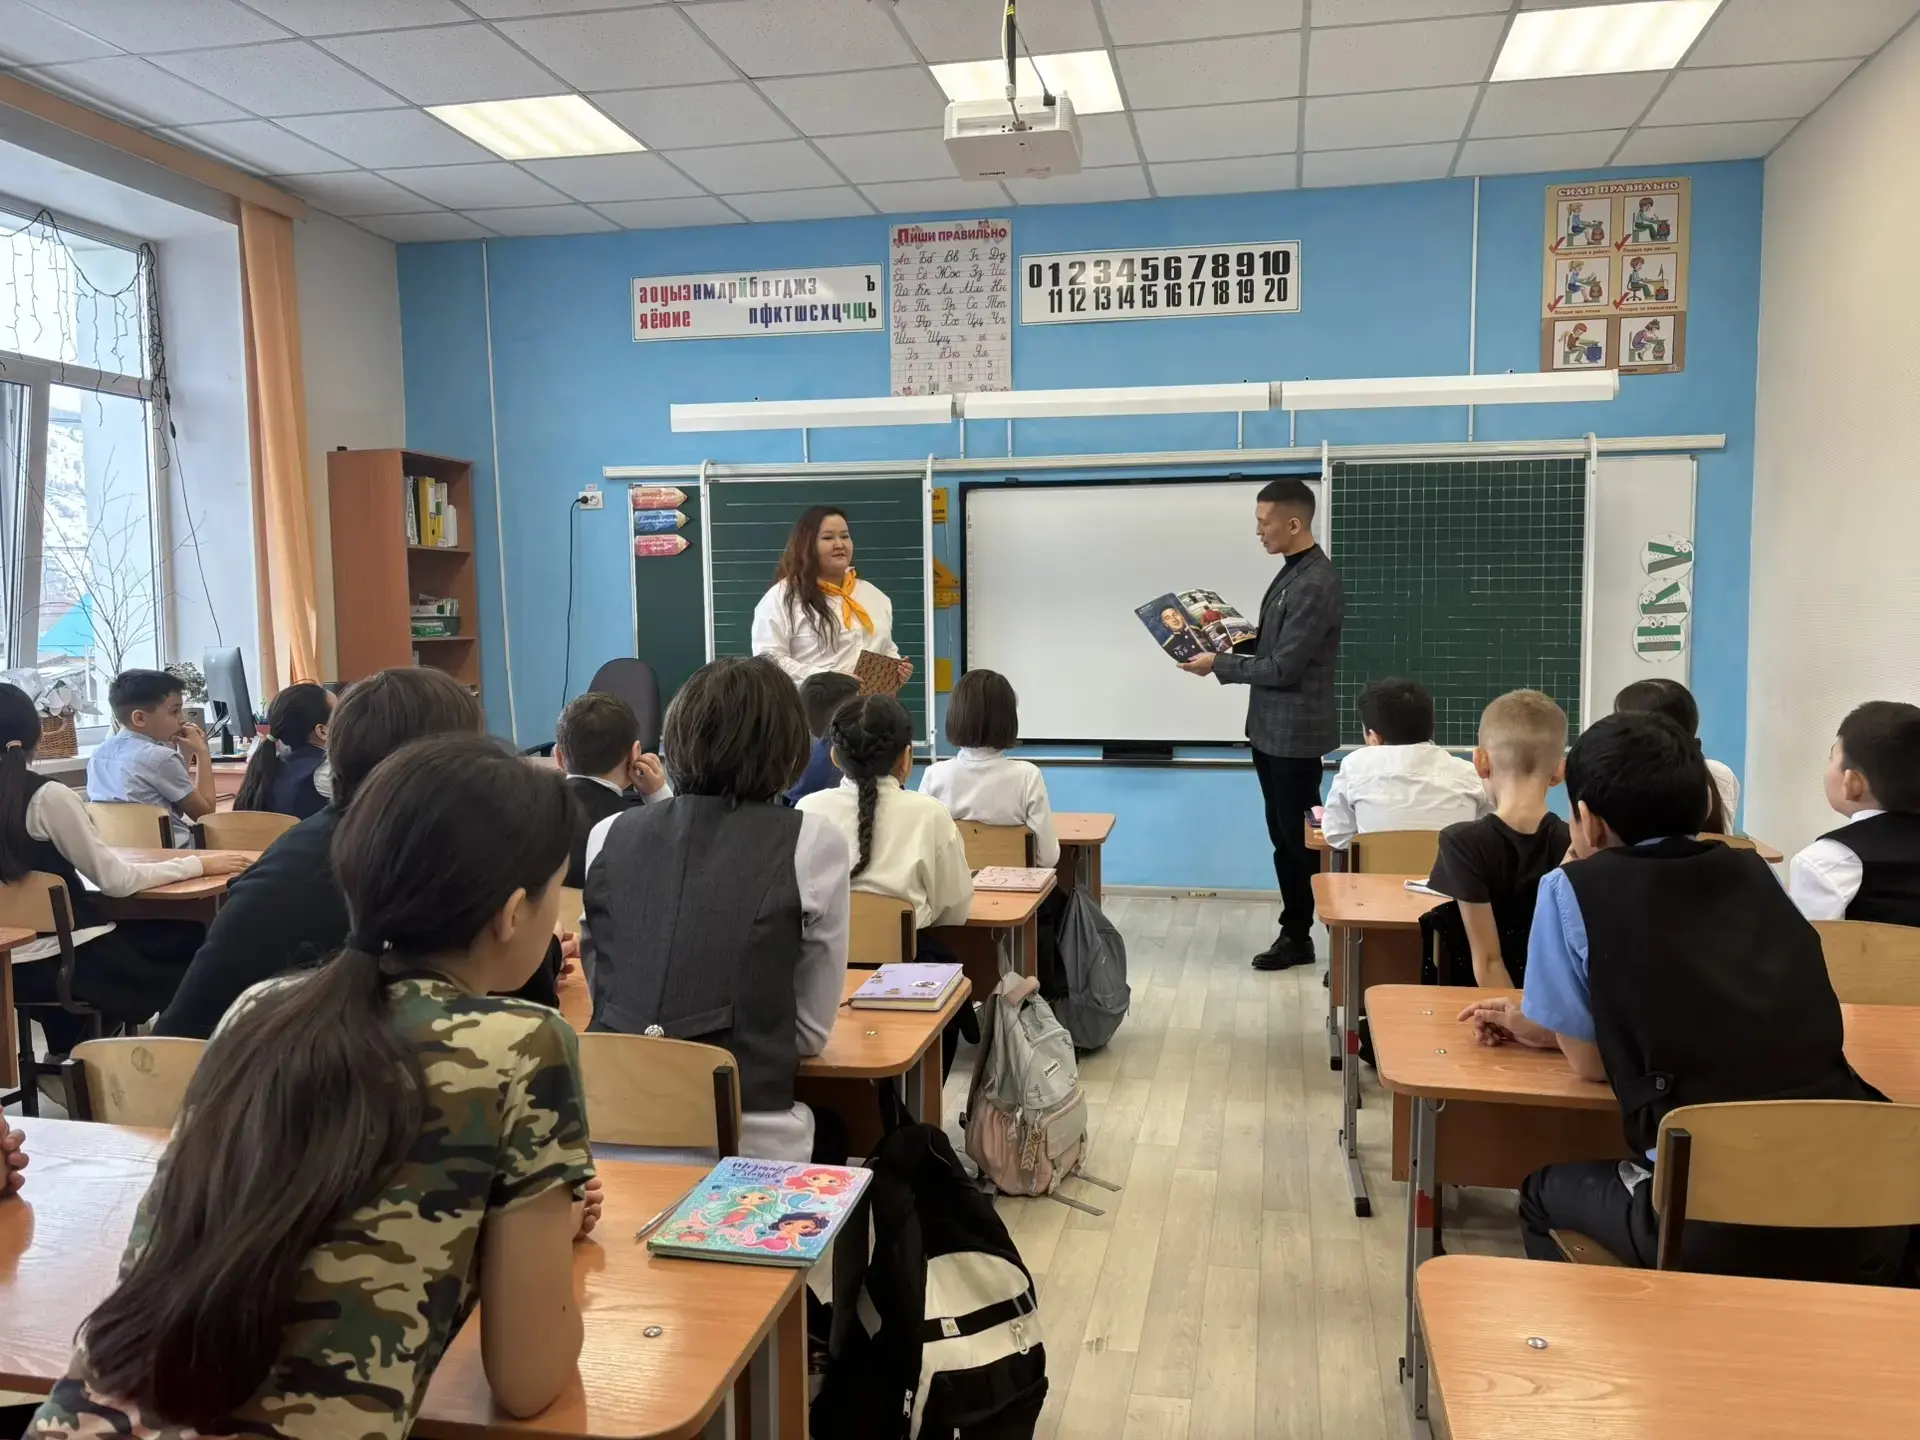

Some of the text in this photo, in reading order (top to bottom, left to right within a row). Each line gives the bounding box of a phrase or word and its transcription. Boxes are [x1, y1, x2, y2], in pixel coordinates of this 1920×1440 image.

[1558, 181, 1680, 197] СИДИ ПРАВИЛЬНО
[944, 250, 960, 262] Вв
[1029, 250, 1290, 288] 0 1 2 3 4 5 6 7 8 9 10
[1048, 277, 1288, 313] 11 12 13 14 15 16 17 18 19 20
